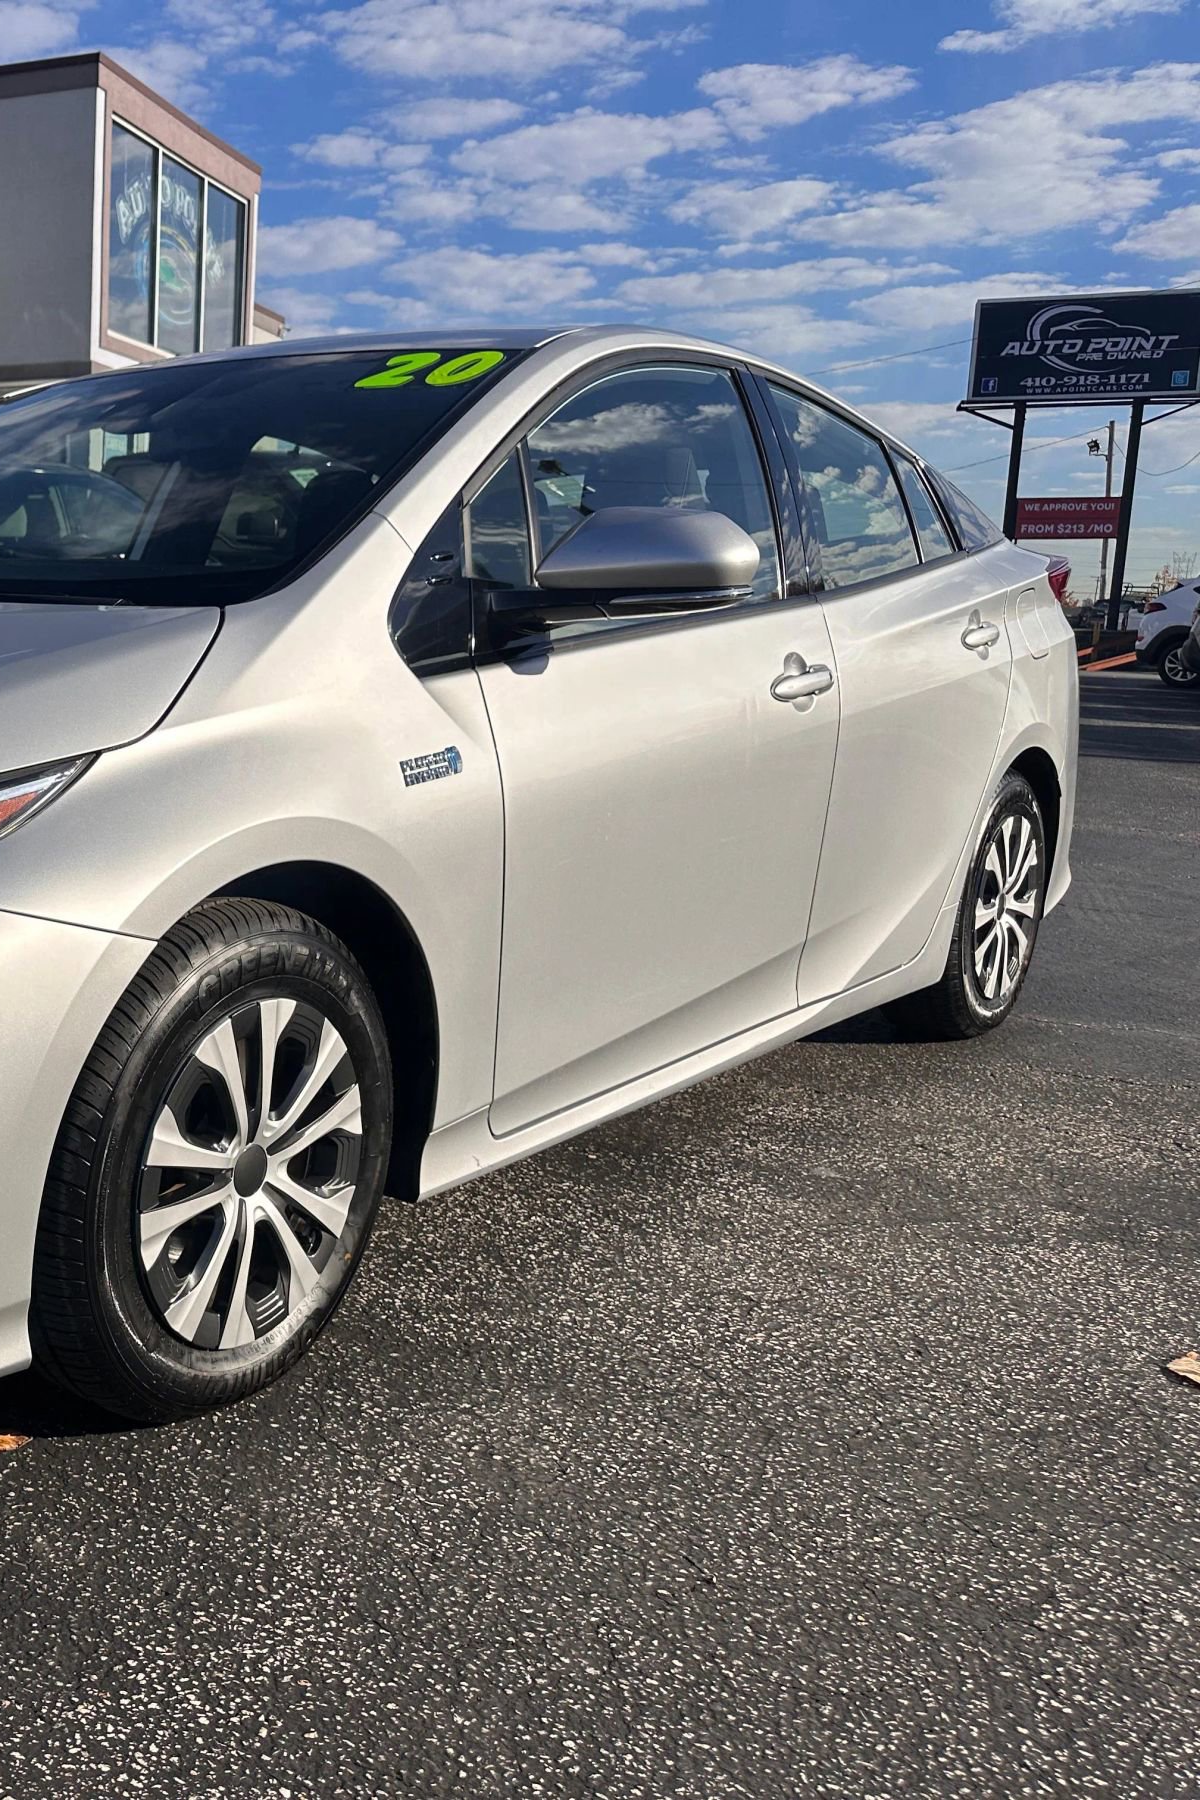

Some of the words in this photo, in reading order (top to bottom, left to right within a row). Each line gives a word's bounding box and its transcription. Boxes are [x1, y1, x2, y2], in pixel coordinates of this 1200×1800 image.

[1000, 338, 1084, 357] AUTO
[1086, 335, 1180, 353] POINT
[1075, 351, 1103, 362] PRE
[1106, 350, 1164, 361] OWNED
[354, 351, 506, 388] 20
[1019, 372, 1150, 386] 410-918-1171
[1026, 384, 1143, 394] WWW.APOINTCARS.COM
[1024, 503, 1040, 511] WE
[1042, 503, 1088, 511] APPROVE
[1090, 502, 1115, 510] YOU!
[1020, 524, 1054, 533] FROM
[1057, 523, 1085, 533] $213
[1087, 523, 1113, 533] /MO
